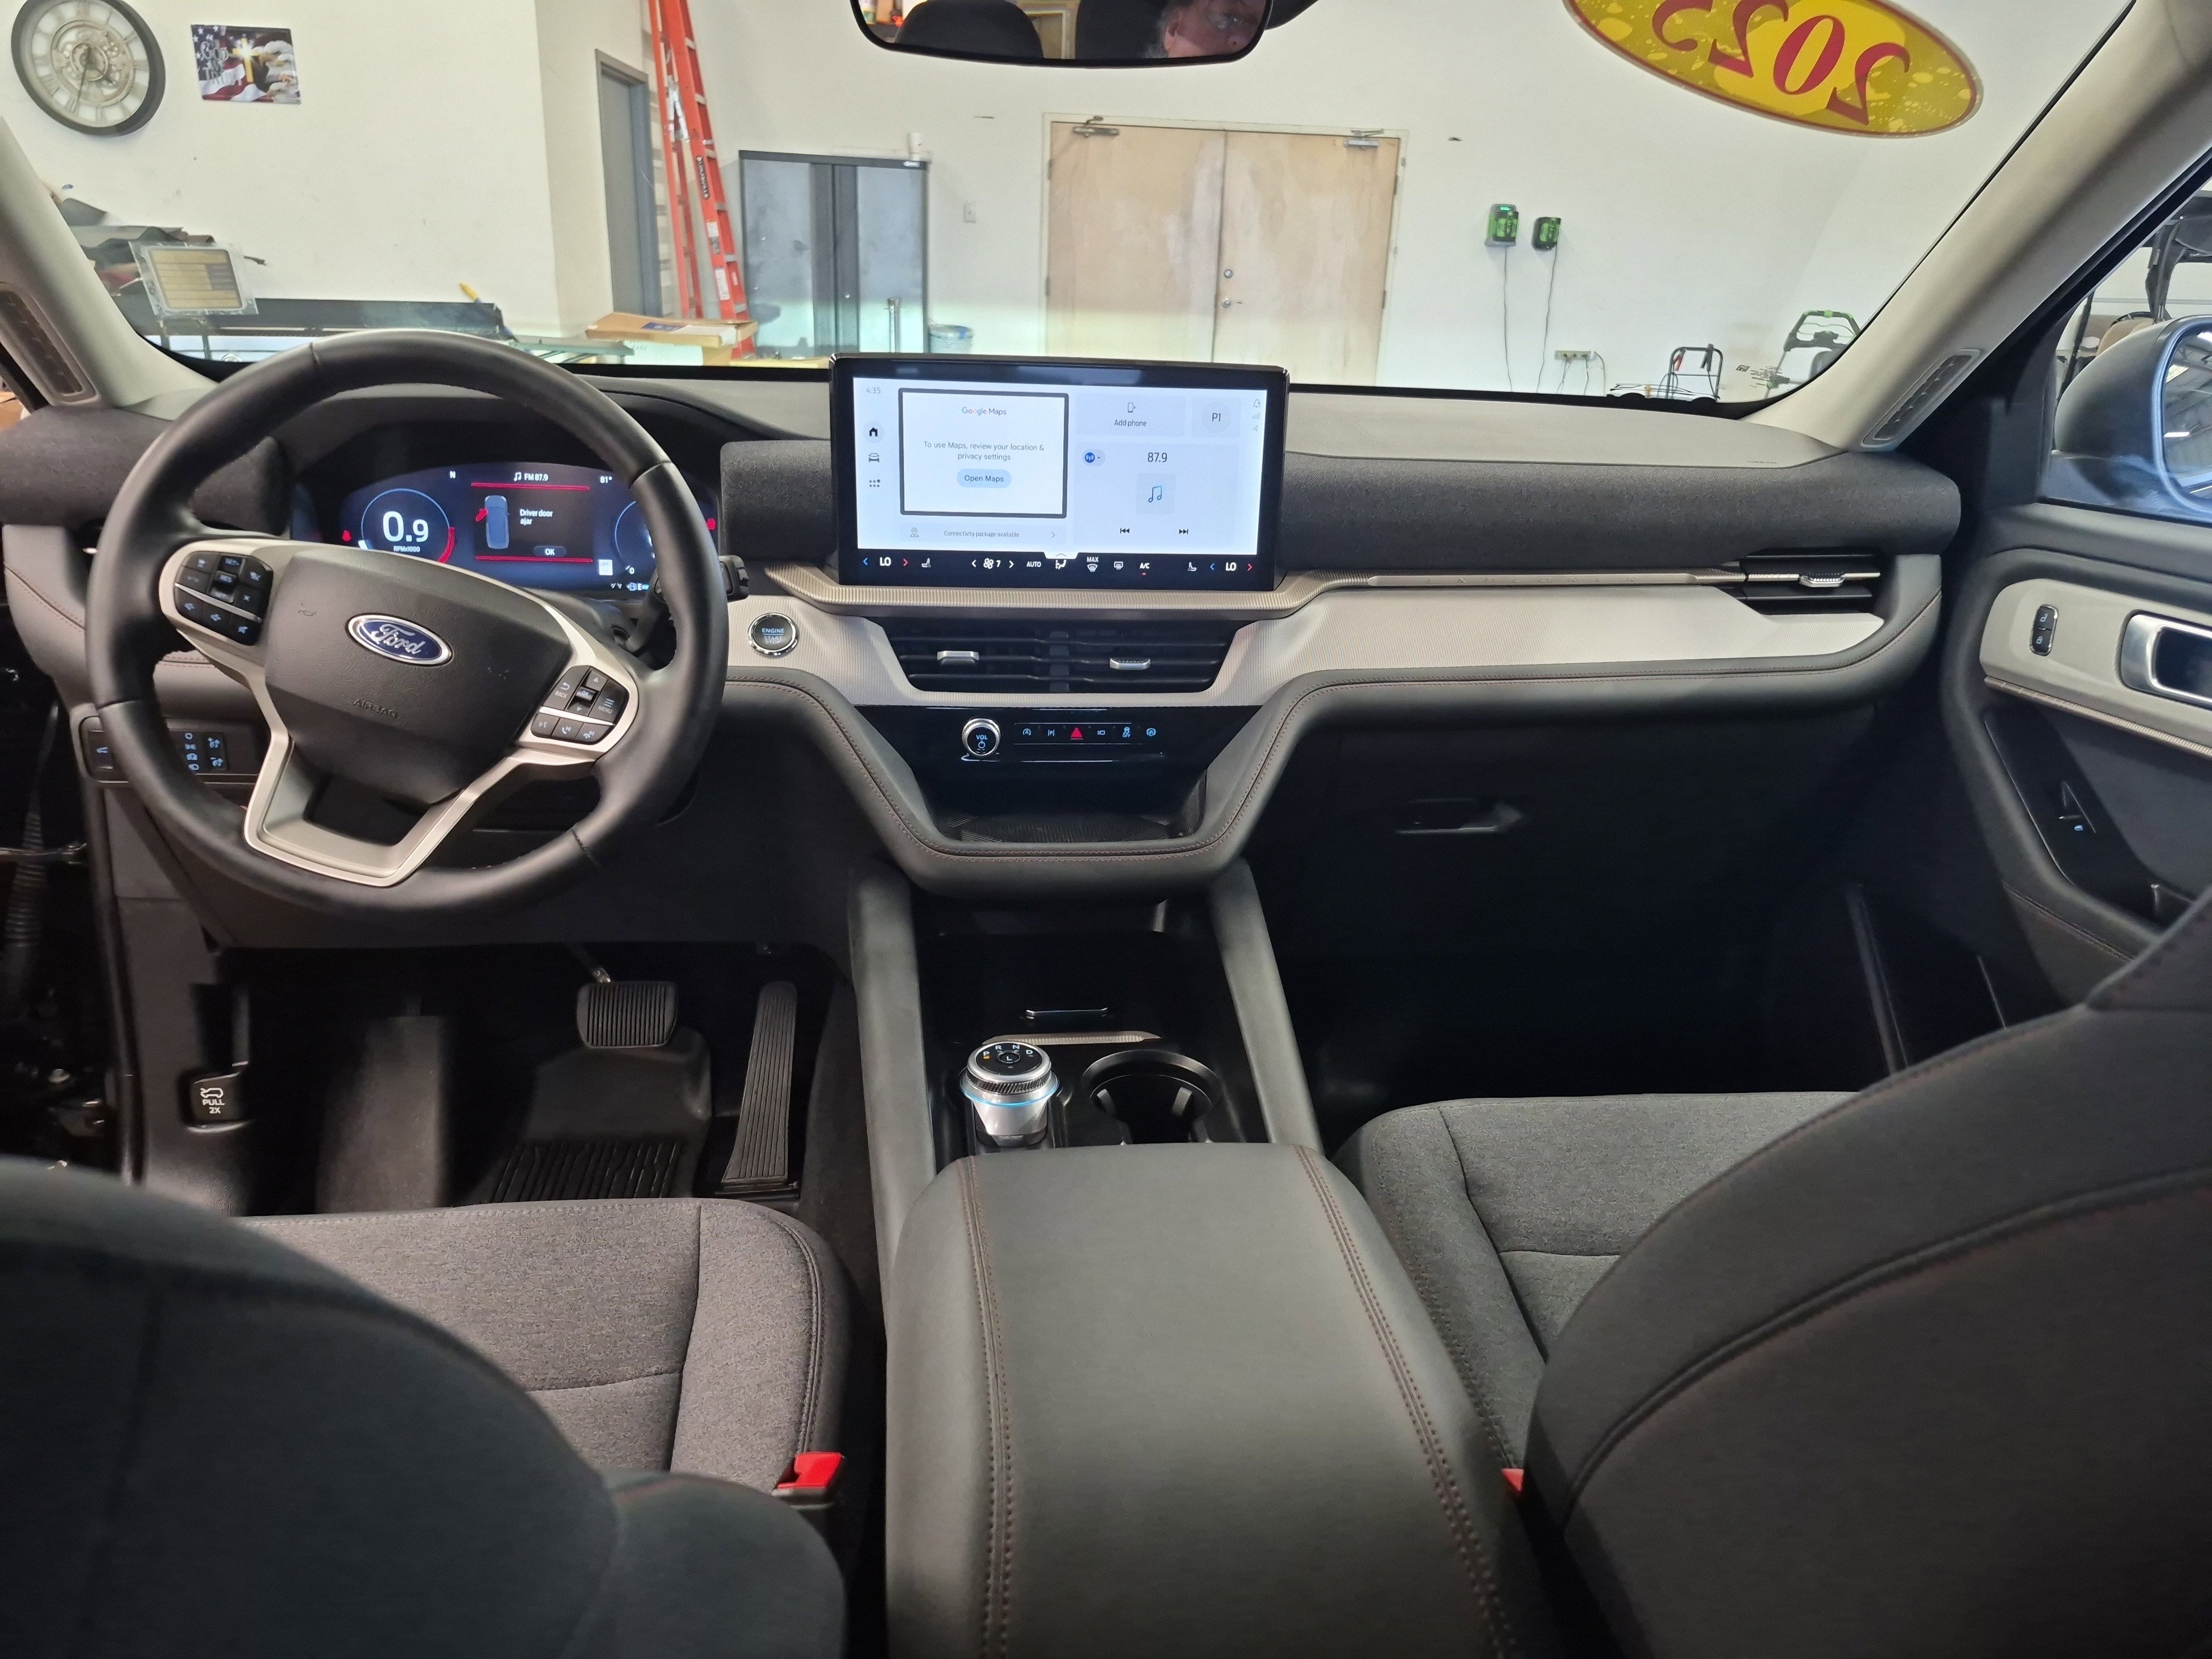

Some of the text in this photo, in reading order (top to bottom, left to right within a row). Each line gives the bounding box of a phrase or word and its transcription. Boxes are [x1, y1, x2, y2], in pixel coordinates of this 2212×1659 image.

[962, 407, 1007, 416] Google Maps
[1212, 413, 1221, 422] P1
[948, 442, 968, 450] Maps,
[1148, 452, 1167, 462] 87.9
[449, 471, 456, 479] N
[964, 475, 1004, 484] Open Maps
[519, 509, 538, 517] Driver
[520, 518, 532, 526] ajar
[383, 511, 428, 543] 0.9
[879, 557, 891, 567] LO
[1226, 562, 1237, 571] LO
[371, 623, 426, 655] Ford
[598, 705, 613, 714] MENU
